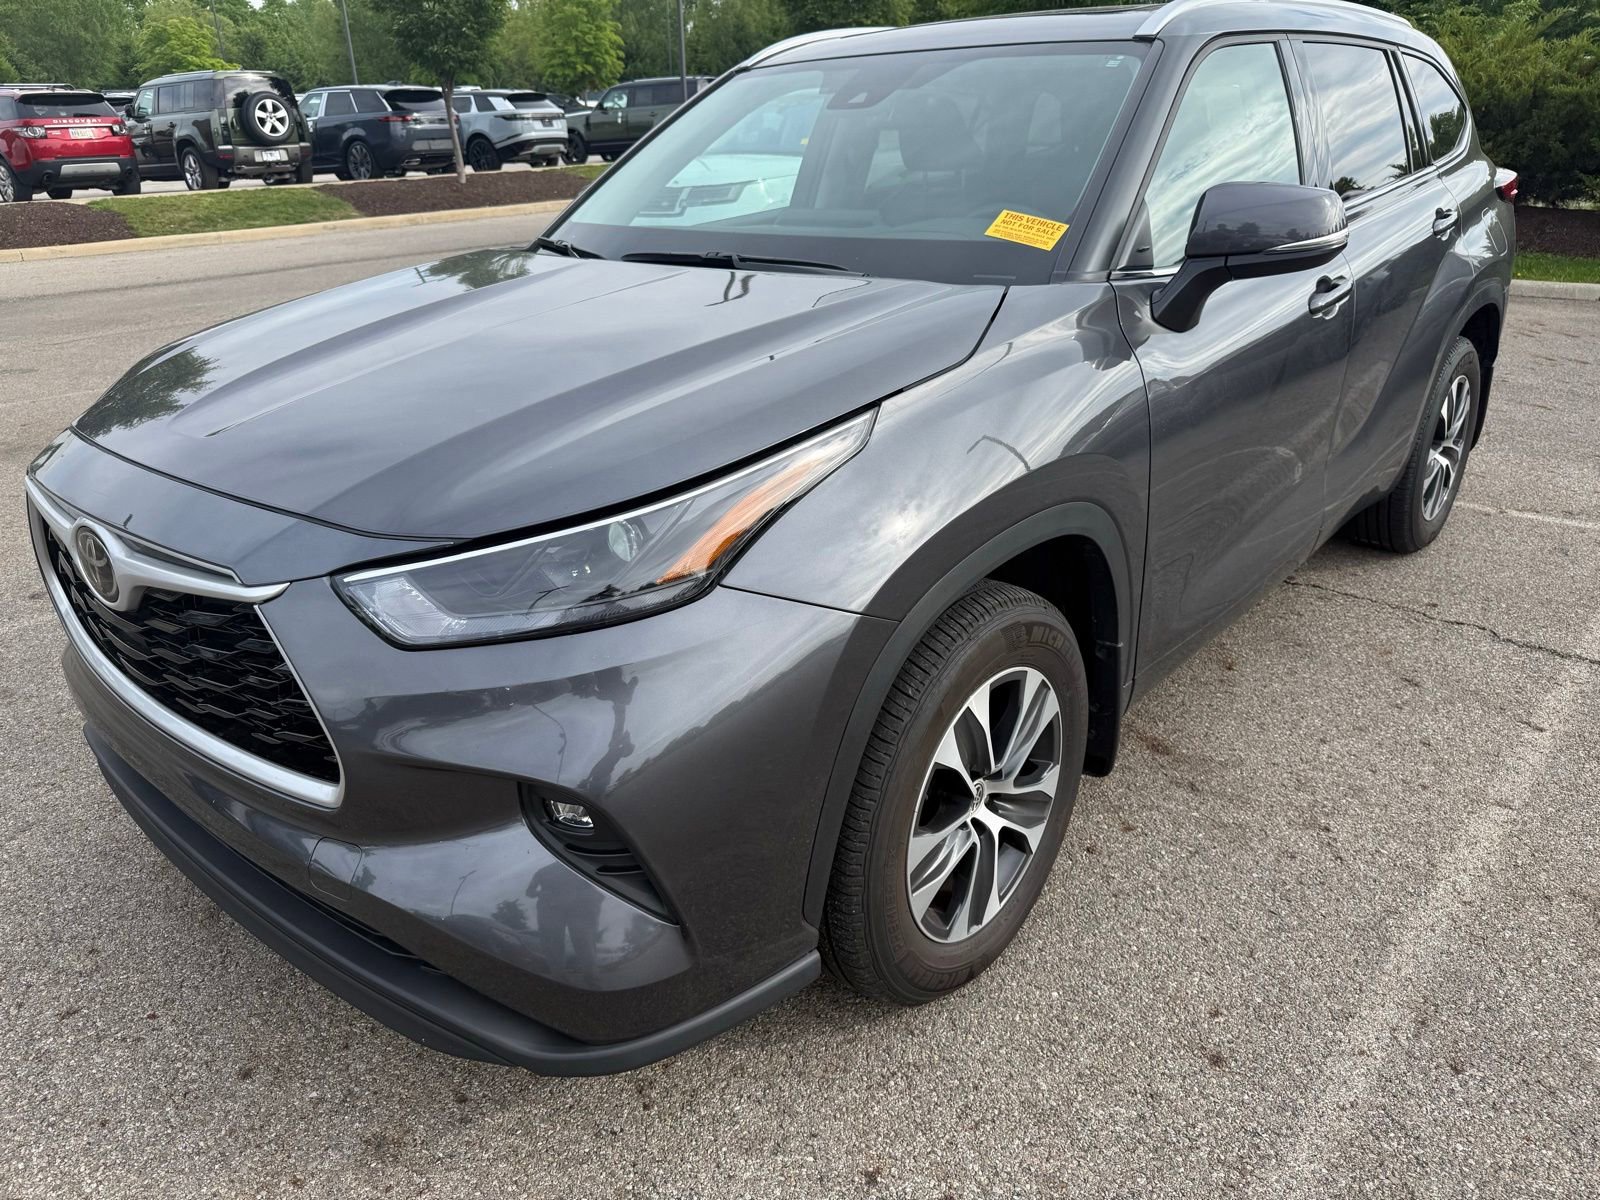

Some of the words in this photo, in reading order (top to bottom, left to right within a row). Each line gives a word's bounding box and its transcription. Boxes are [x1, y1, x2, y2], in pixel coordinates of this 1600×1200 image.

[1004, 212, 1024, 221] THIS
[1027, 217, 1064, 231] VEHICLE
[1036, 228, 1056, 236] SALE
